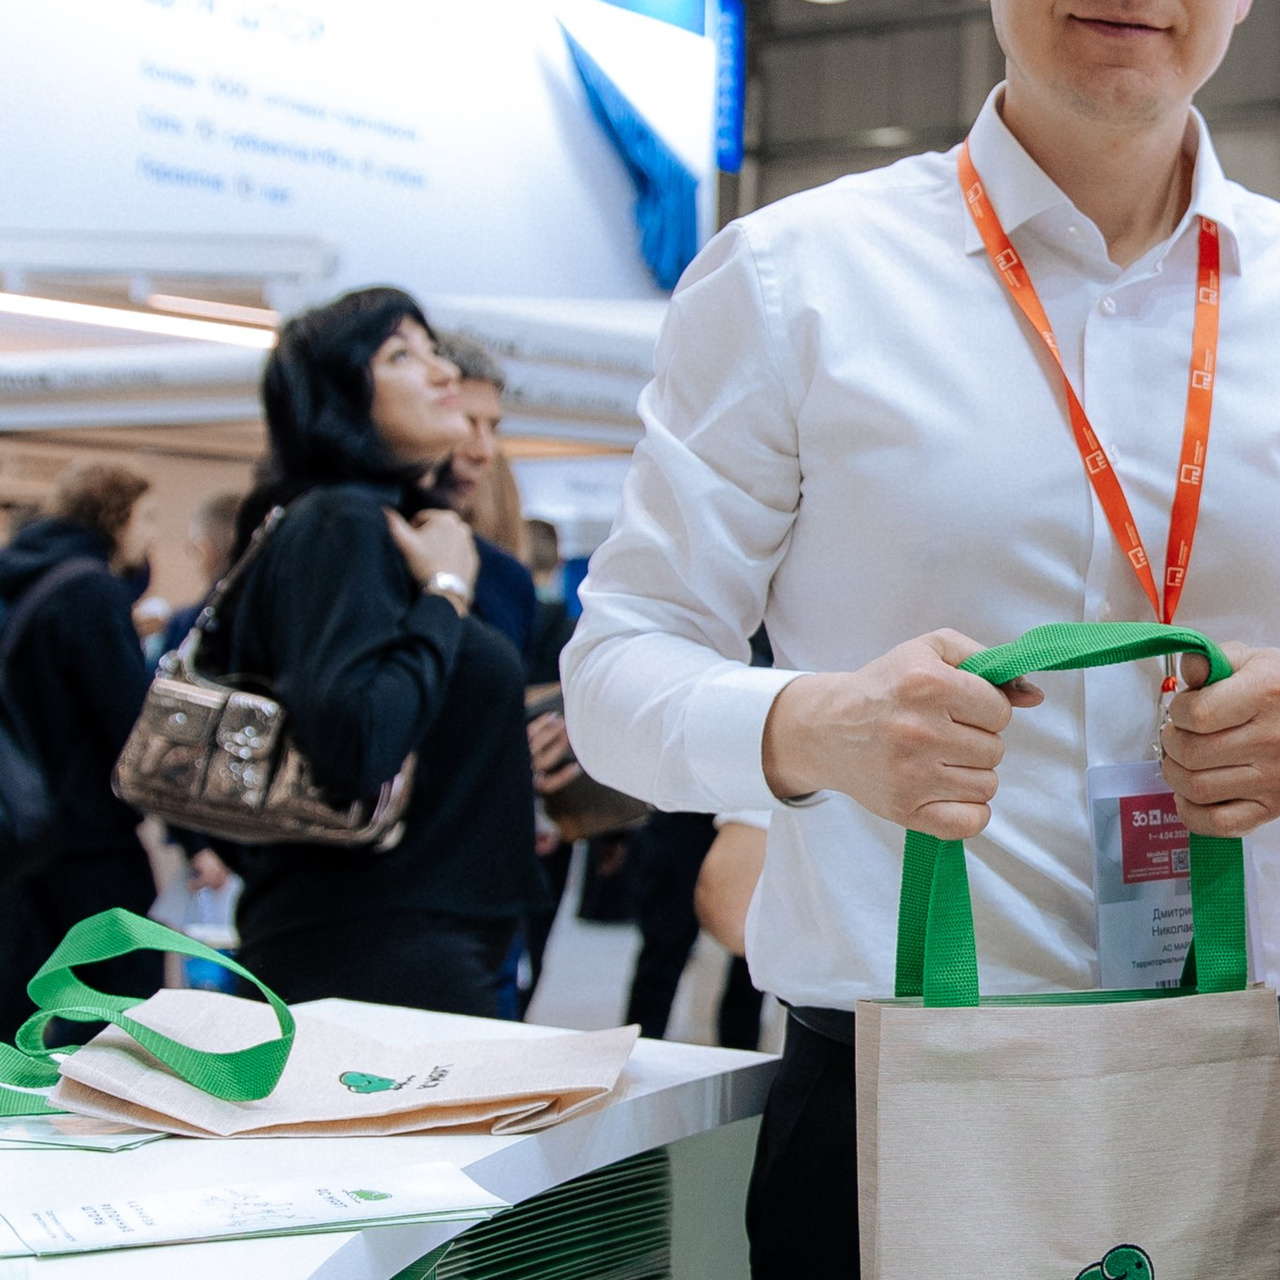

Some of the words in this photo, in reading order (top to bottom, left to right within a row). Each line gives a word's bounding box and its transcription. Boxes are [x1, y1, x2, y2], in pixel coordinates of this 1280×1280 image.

[1153, 908, 1192, 921] Дмитри
[1152, 924, 1194, 936] Николае
[1174, 941, 1190, 950] МАР
